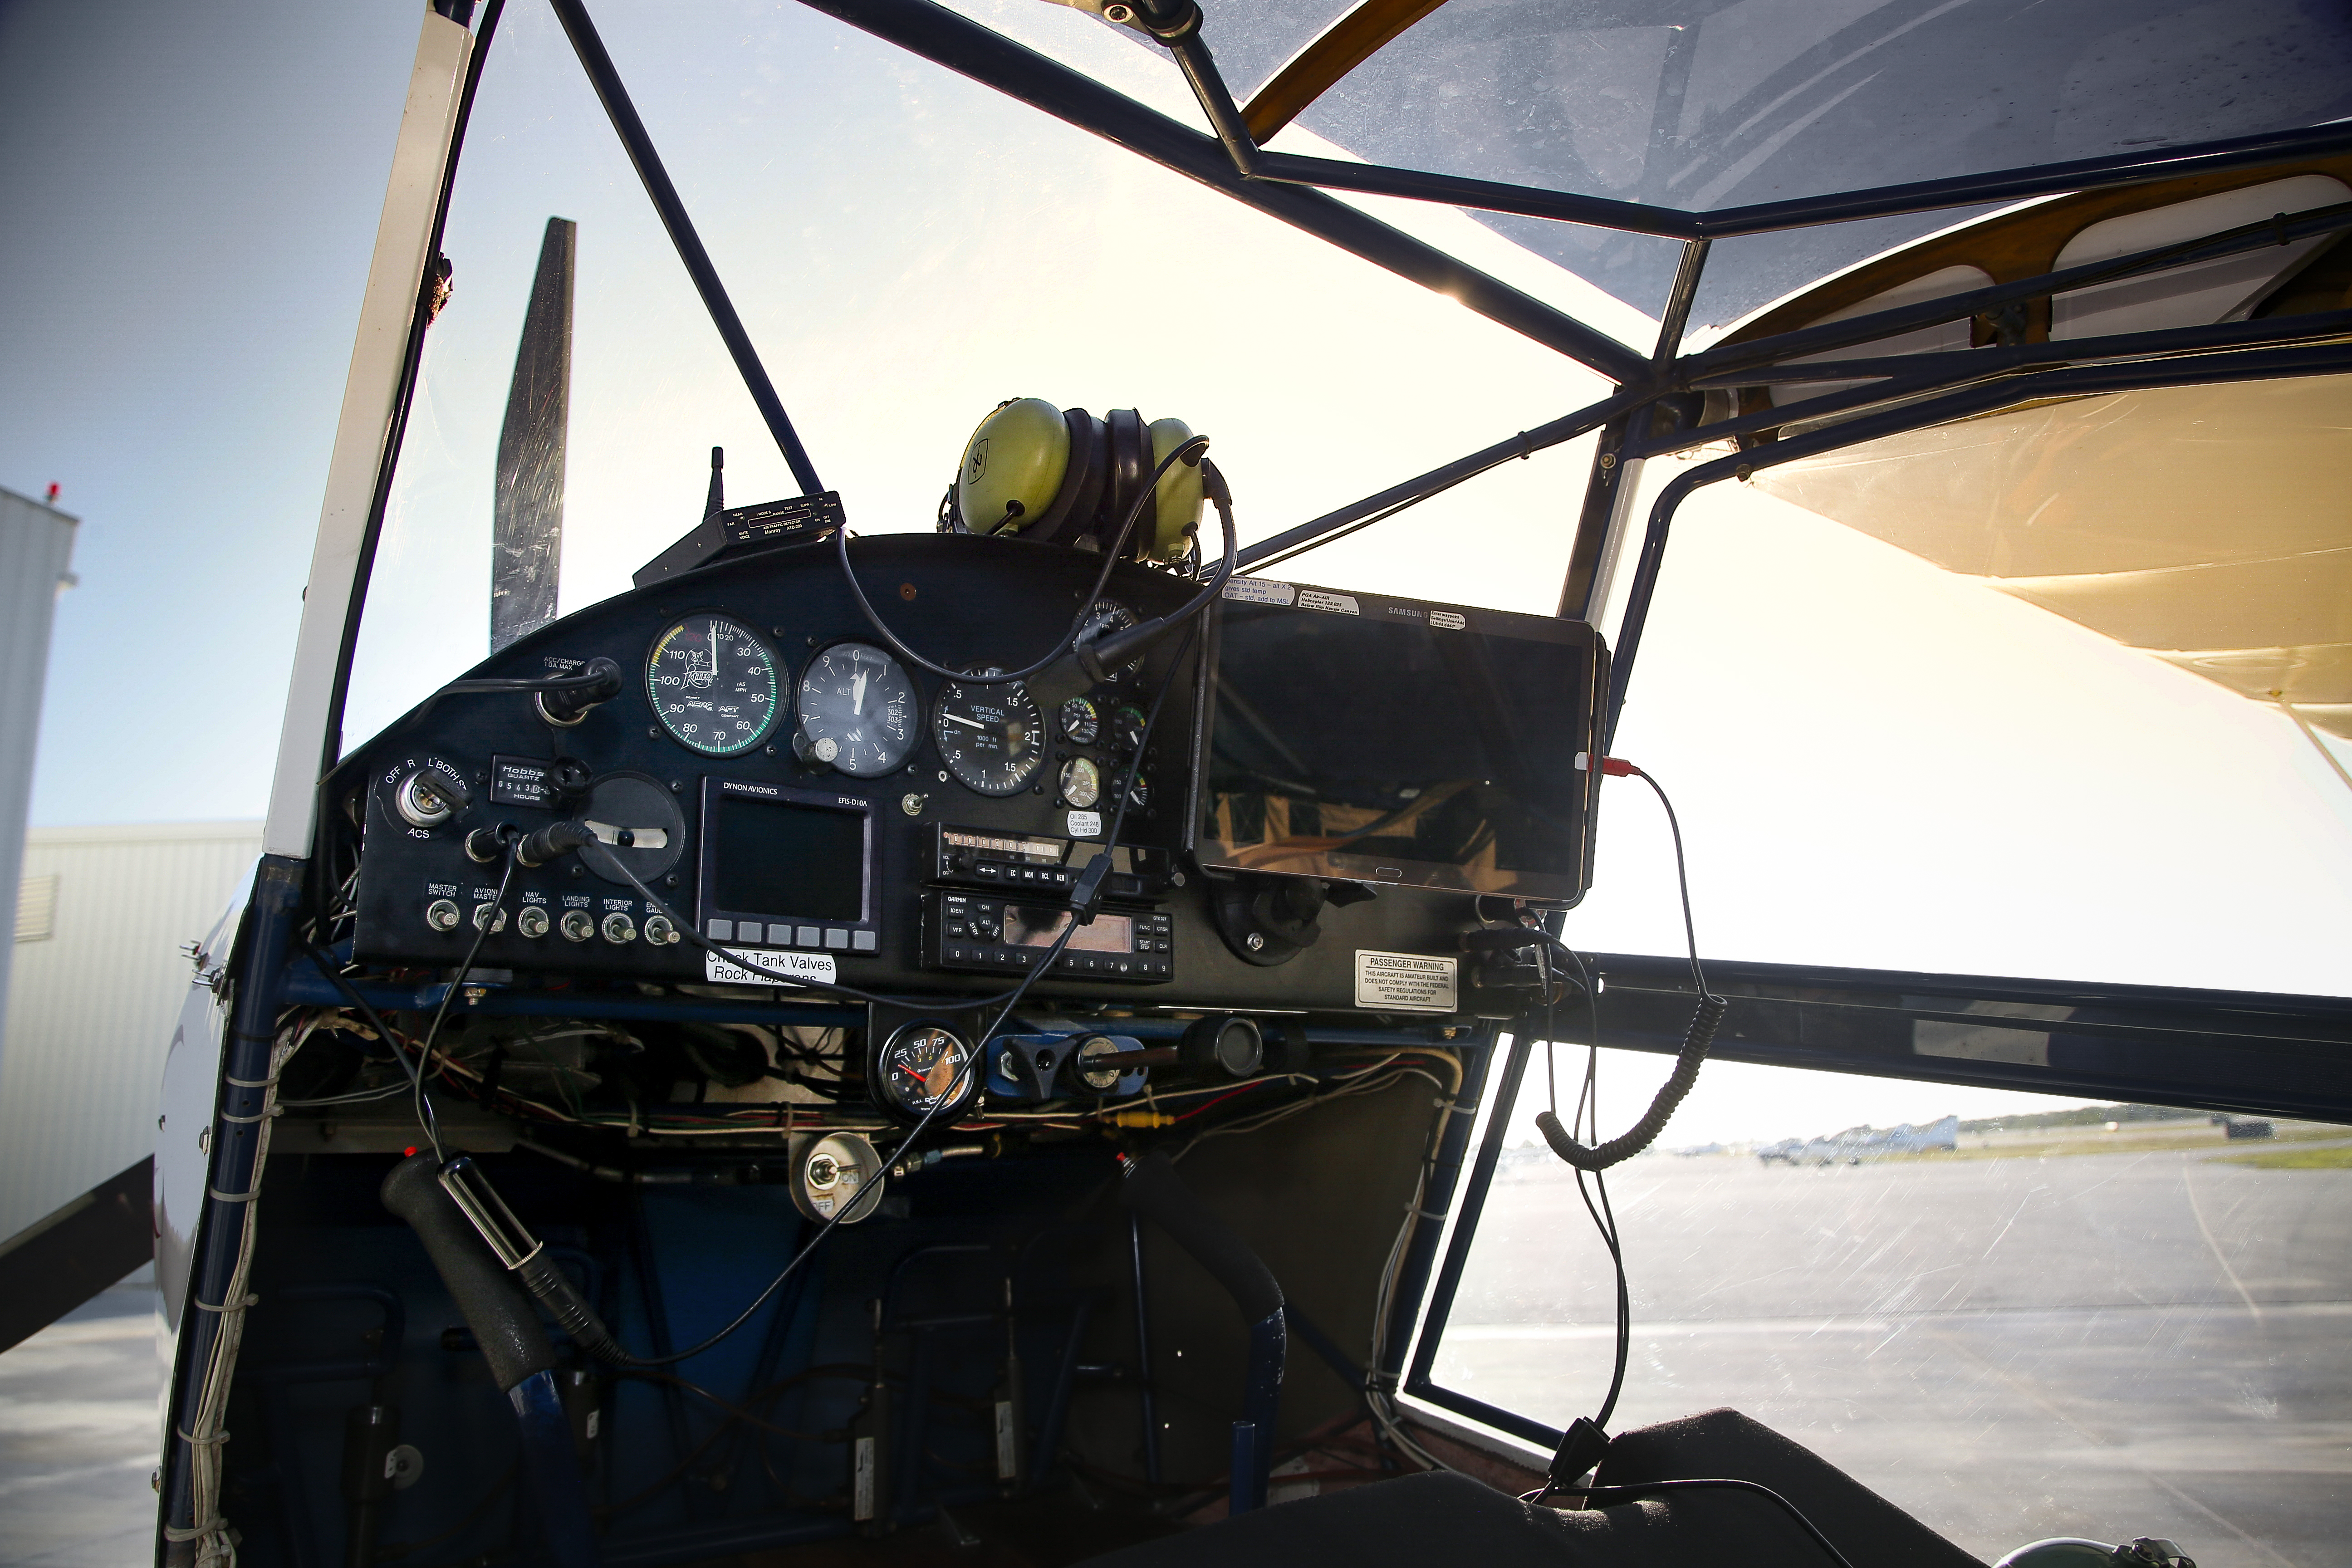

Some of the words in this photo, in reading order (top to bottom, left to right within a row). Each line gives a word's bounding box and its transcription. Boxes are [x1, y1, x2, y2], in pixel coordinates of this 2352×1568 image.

[1389, 607, 1428, 618] SAMSUNG
[670, 650, 685, 659] 110
[737, 647, 751, 657] 30
[853, 650, 859, 661] 0
[823, 656, 830, 667] 9
[748, 667, 761, 675] 40
[661, 676, 680, 686] 100
[803, 681, 810, 691] 8
[751, 694, 764, 702] 50
[898, 692, 905, 703] 2
[1007, 697, 1018, 706] 1.5
[669, 704, 685, 713] 90
[971, 706, 1004, 716] VERTICAL
[977, 714, 999, 722] SPEED
[683, 724, 697, 732] 80
[736, 721, 750, 730] 60
[713, 731, 726, 740] 70
[897, 729, 904, 740] 3
[1025, 732, 1030, 740] 2
[878, 752, 886, 763] 4
[407, 759, 416, 768] R
[849, 759, 856, 770] 5
[1005, 762, 1016, 771] 1.5
[386, 766, 400, 784] OFF
[436, 760, 460, 780] BOTH
[503, 766, 544, 776] Hobbs
[724, 782, 747, 791] DYNON
[748, 785, 777, 795] AVIONICS
[838, 797, 867, 807] EFIS-D10A
[407, 828, 429, 838] ACS
[970, 923, 979, 936] STBY
[754, 953, 785, 967] Tank
[790, 956, 832, 970] Valves
[1371, 958, 1411, 968] PASSENGER
[1413, 961, 1444, 970] WARNING
[714, 966, 748, 980] Rock
[914, 1039, 926, 1049] 50
[932, 1037, 945, 1046] 75
[895, 1049, 906, 1058] 25
[945, 1054, 960, 1065] 100
[892, 1072, 898, 1081] 0
